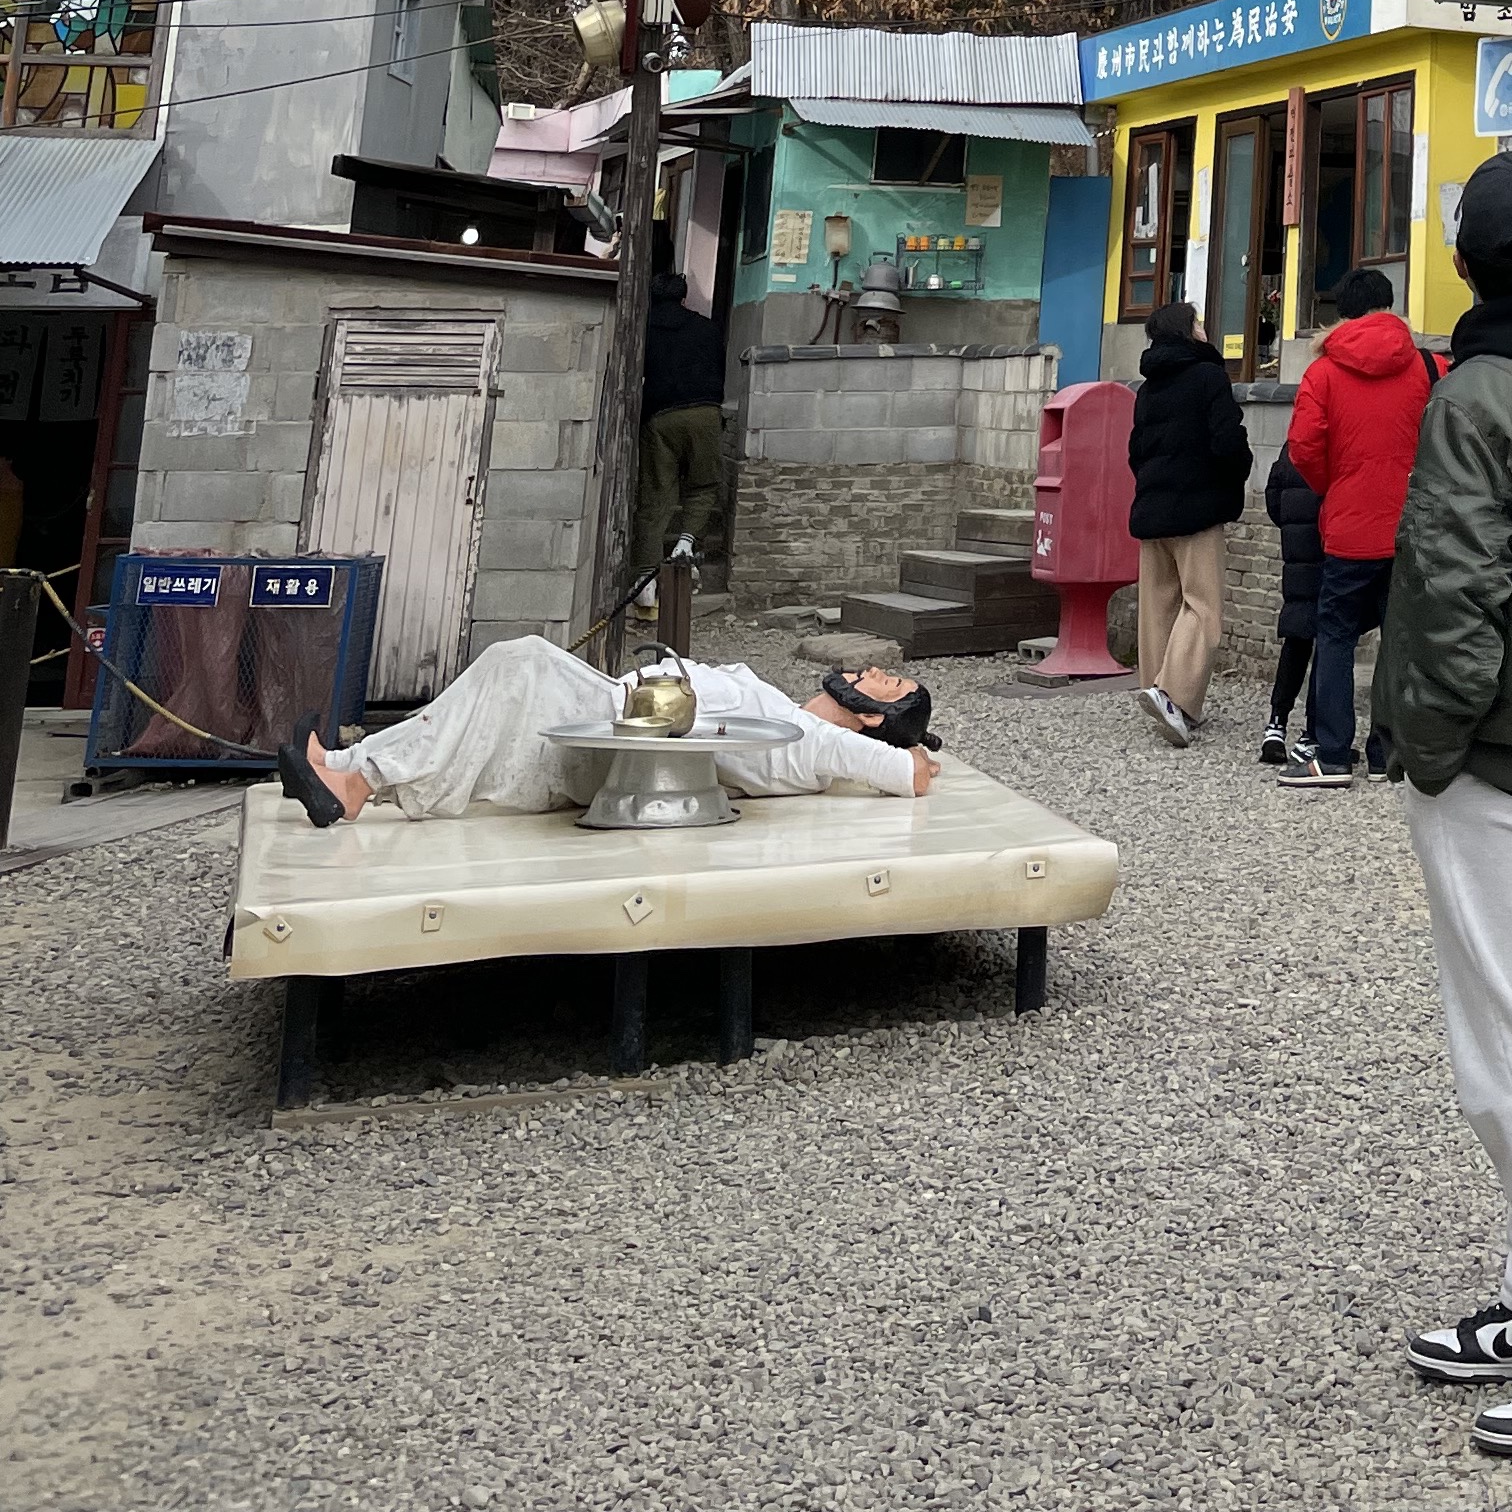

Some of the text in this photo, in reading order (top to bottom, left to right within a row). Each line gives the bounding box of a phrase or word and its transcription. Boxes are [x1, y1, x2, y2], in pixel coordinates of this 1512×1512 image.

[1039, 511, 1054, 526] POST
[142, 575, 217, 595] 일반쓰레기
[265, 578, 319, 596] 재활용
